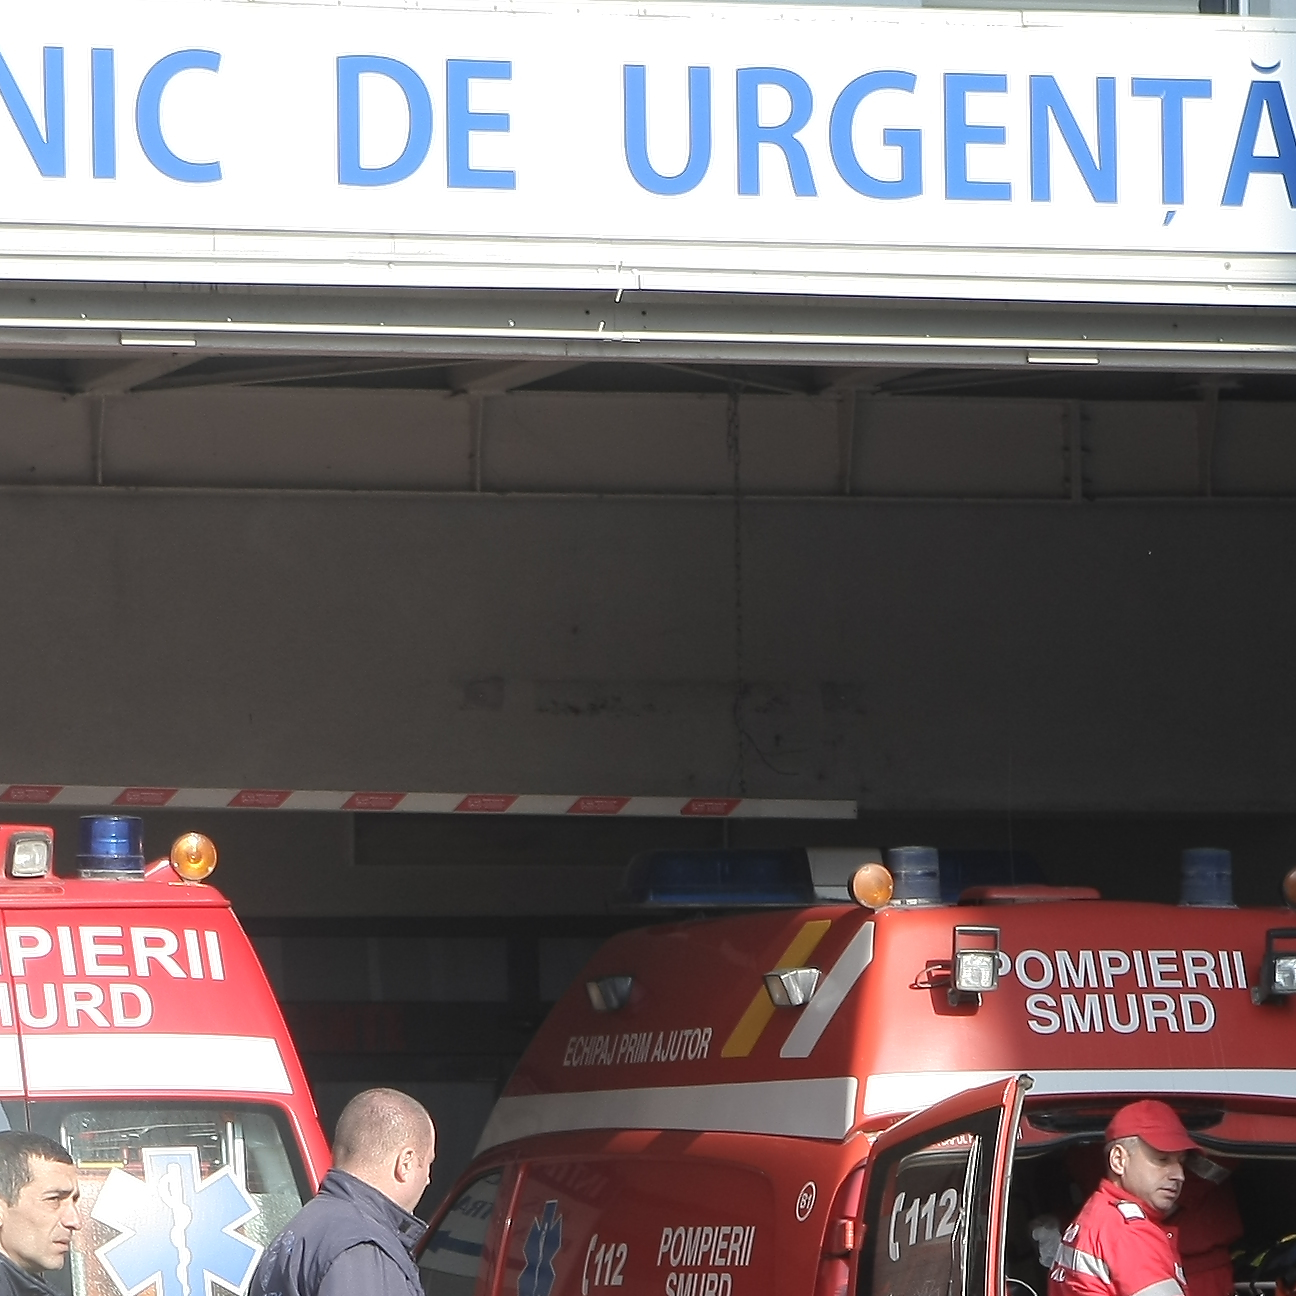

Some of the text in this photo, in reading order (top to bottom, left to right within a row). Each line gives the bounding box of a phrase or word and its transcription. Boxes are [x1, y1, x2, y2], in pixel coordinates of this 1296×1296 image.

[337, 55, 516, 189] DE
[1026, 993, 1217, 1034] SMURD
[563, 1027, 713, 1067] ECHIPAJ PRIM AJUTOR
[904, 1188, 958, 1246] 112
[593, 1242, 628, 1287] 112
[657, 1225, 756, 1268] POMPIERII
